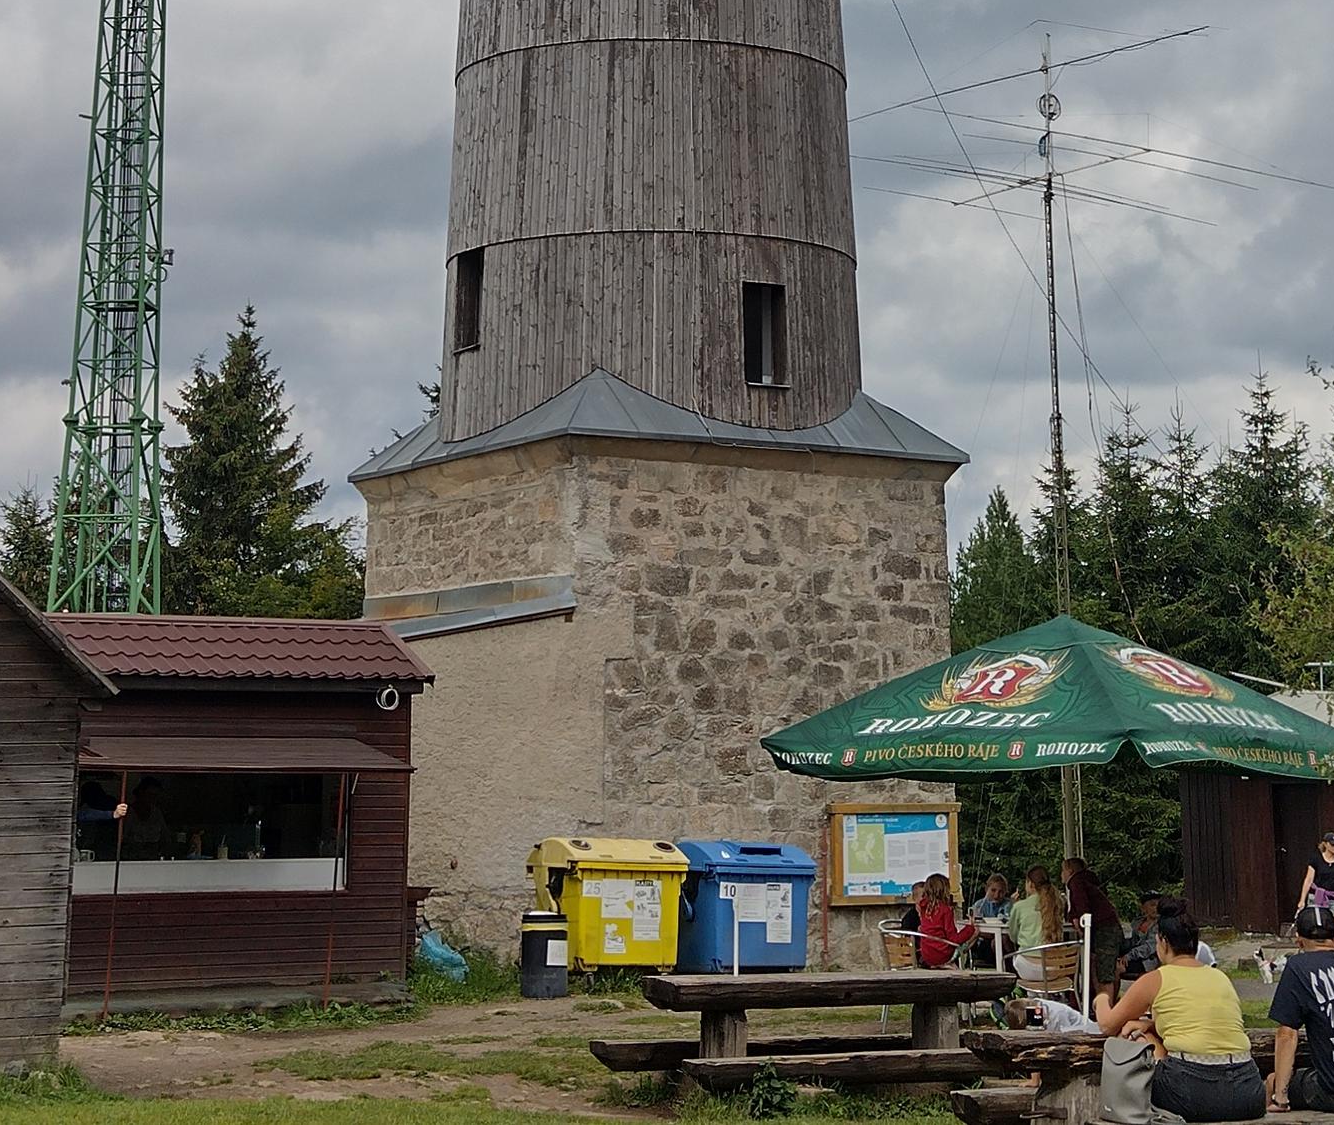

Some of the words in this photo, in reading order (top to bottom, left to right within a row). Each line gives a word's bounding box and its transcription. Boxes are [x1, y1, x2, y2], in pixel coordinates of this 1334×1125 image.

[969, 667, 1019, 696] R
[856, 708, 1052, 734] ROHOZEC
[864, 747, 895, 762] PIVO
[898, 739, 965, 760] ČESKÉHO
[968, 741, 1000, 762] RÁJE
[1035, 741, 1109, 758] ROHOZEC
[585, 882, 601, 895] 25
[723, 884, 737, 897] 10
